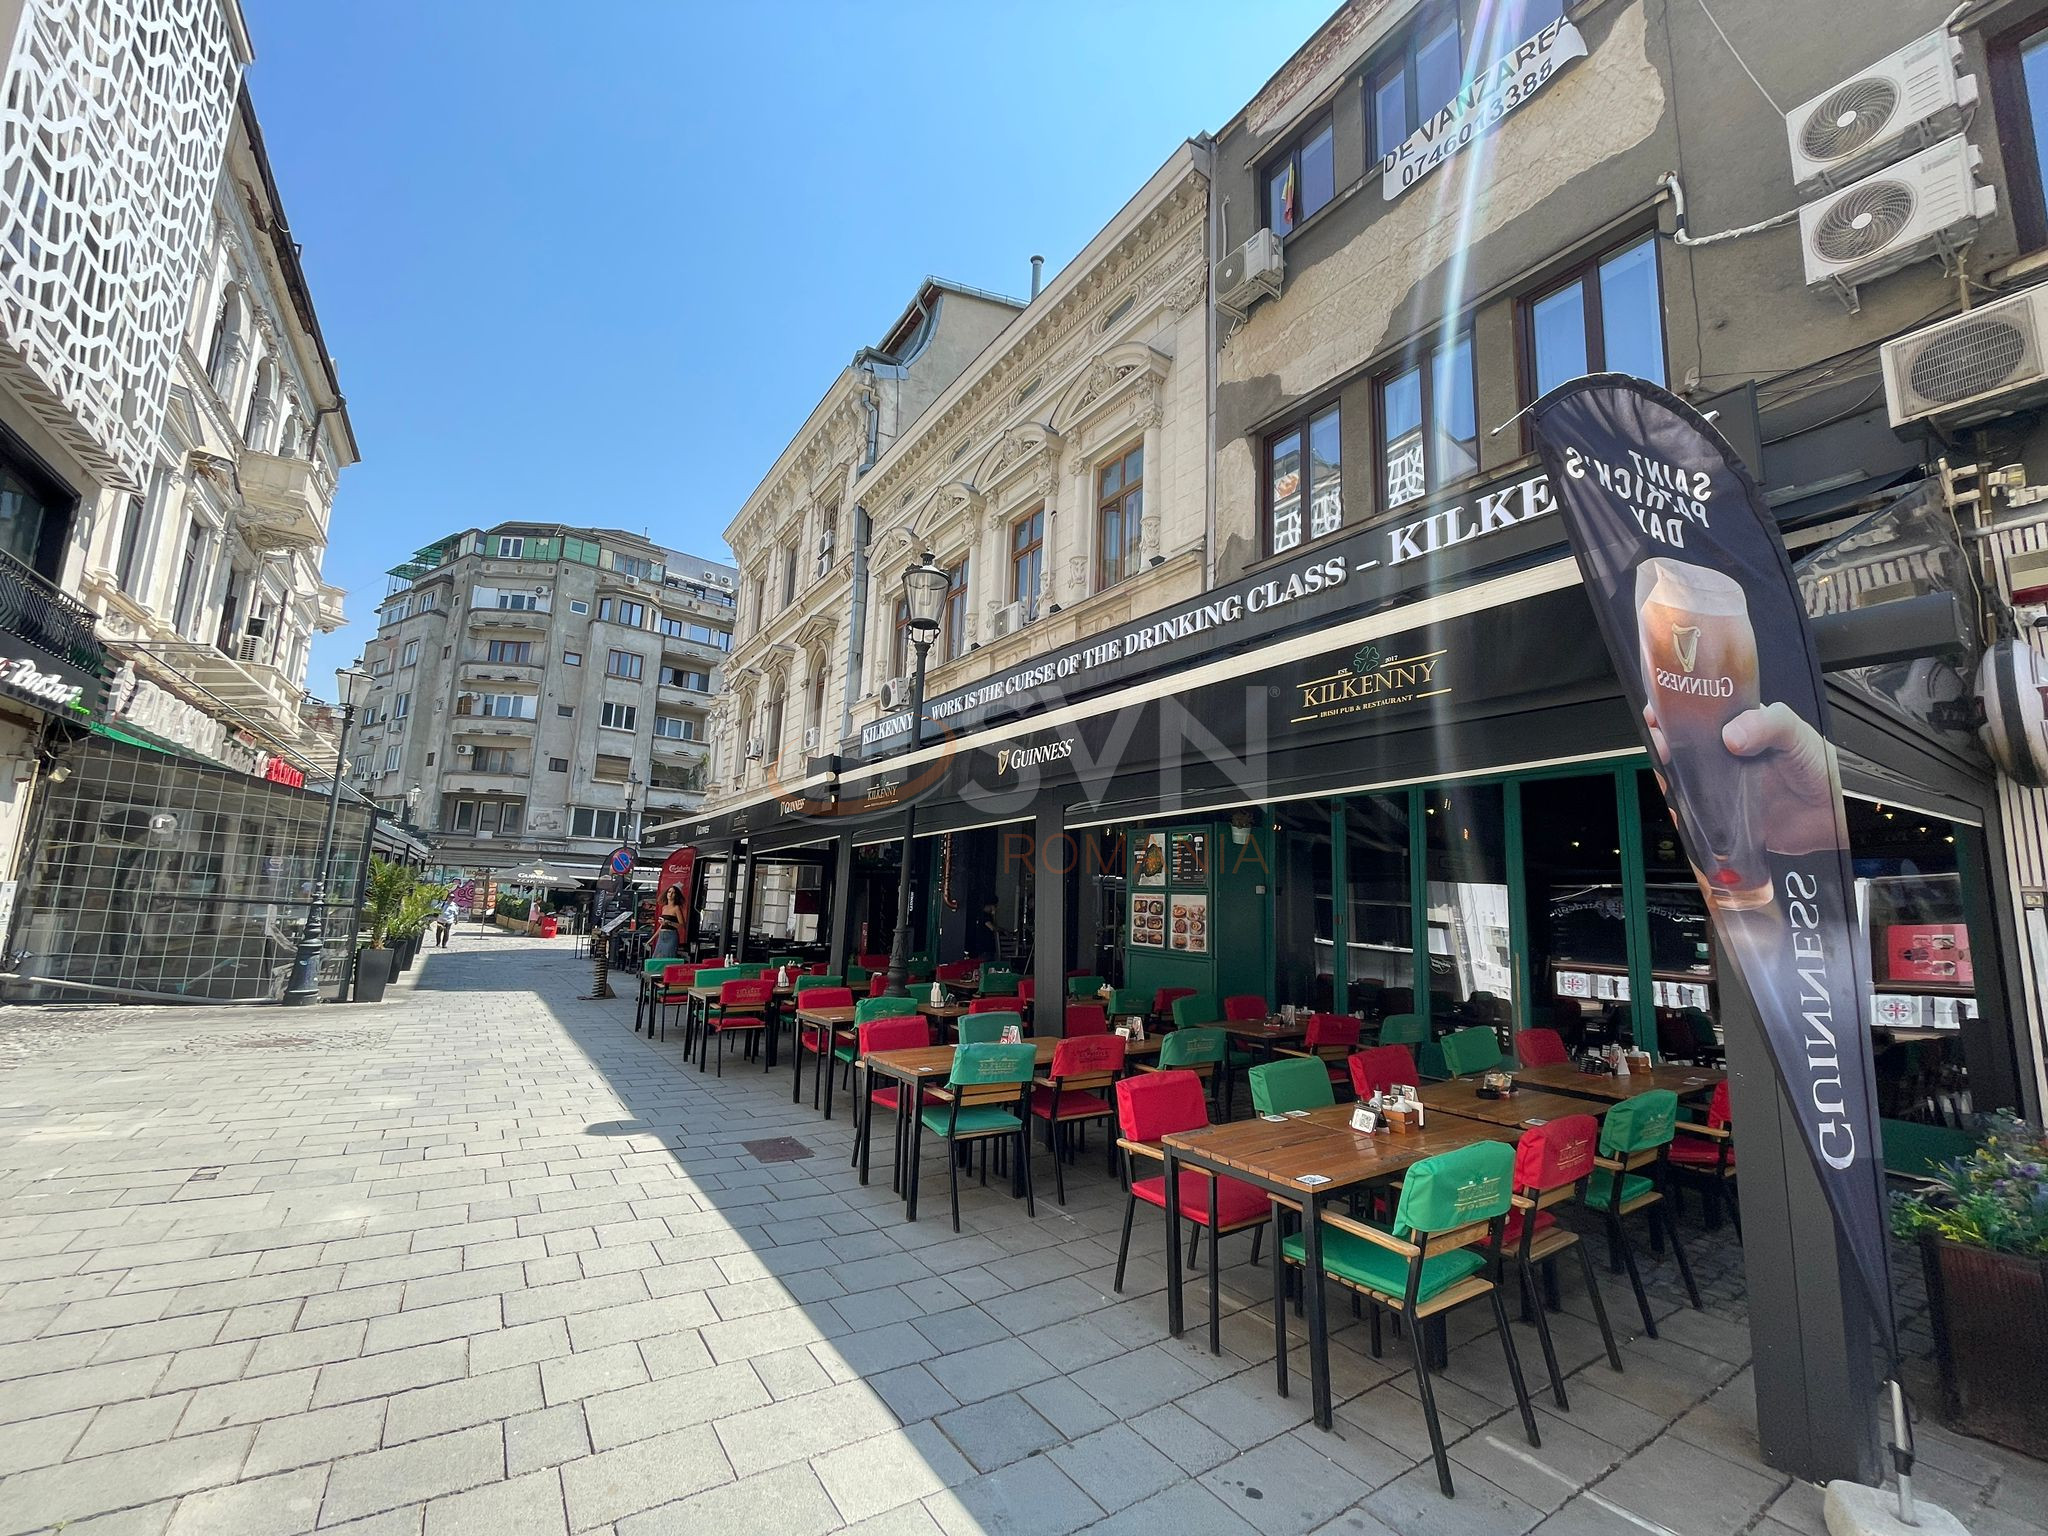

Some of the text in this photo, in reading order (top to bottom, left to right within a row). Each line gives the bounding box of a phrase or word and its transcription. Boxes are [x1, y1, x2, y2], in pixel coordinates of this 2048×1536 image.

[1384, 22, 1556, 174] DE VANZARE
[1403, 58, 1552, 187] 0746013388
[862, 711, 914, 746] KILKENNY
[931, 701, 963, 720] WORK
[963, 691, 977, 710] IS
[978, 682, 1005, 705] THE
[1005, 662, 1055, 695] CURSE
[1057, 653, 1080, 678] OF
[1082, 638, 1122, 670] THE
[1123, 594, 1243, 657] DRINKING
[1247, 556, 1346, 613] CLASS
[1387, 474, 1557, 567] KILKE
[1303, 660, 1438, 708] KILKENNY
[1320, 708, 1339, 718] IRISH
[1340, 705, 1354, 715] PUB
[1362, 695, 1413, 710] RESTAURANT
[1011, 738, 1074, 771] GUINNESS
[867, 787, 899, 801] KILKENNY
[668, 864, 691, 873] Carlsberg
